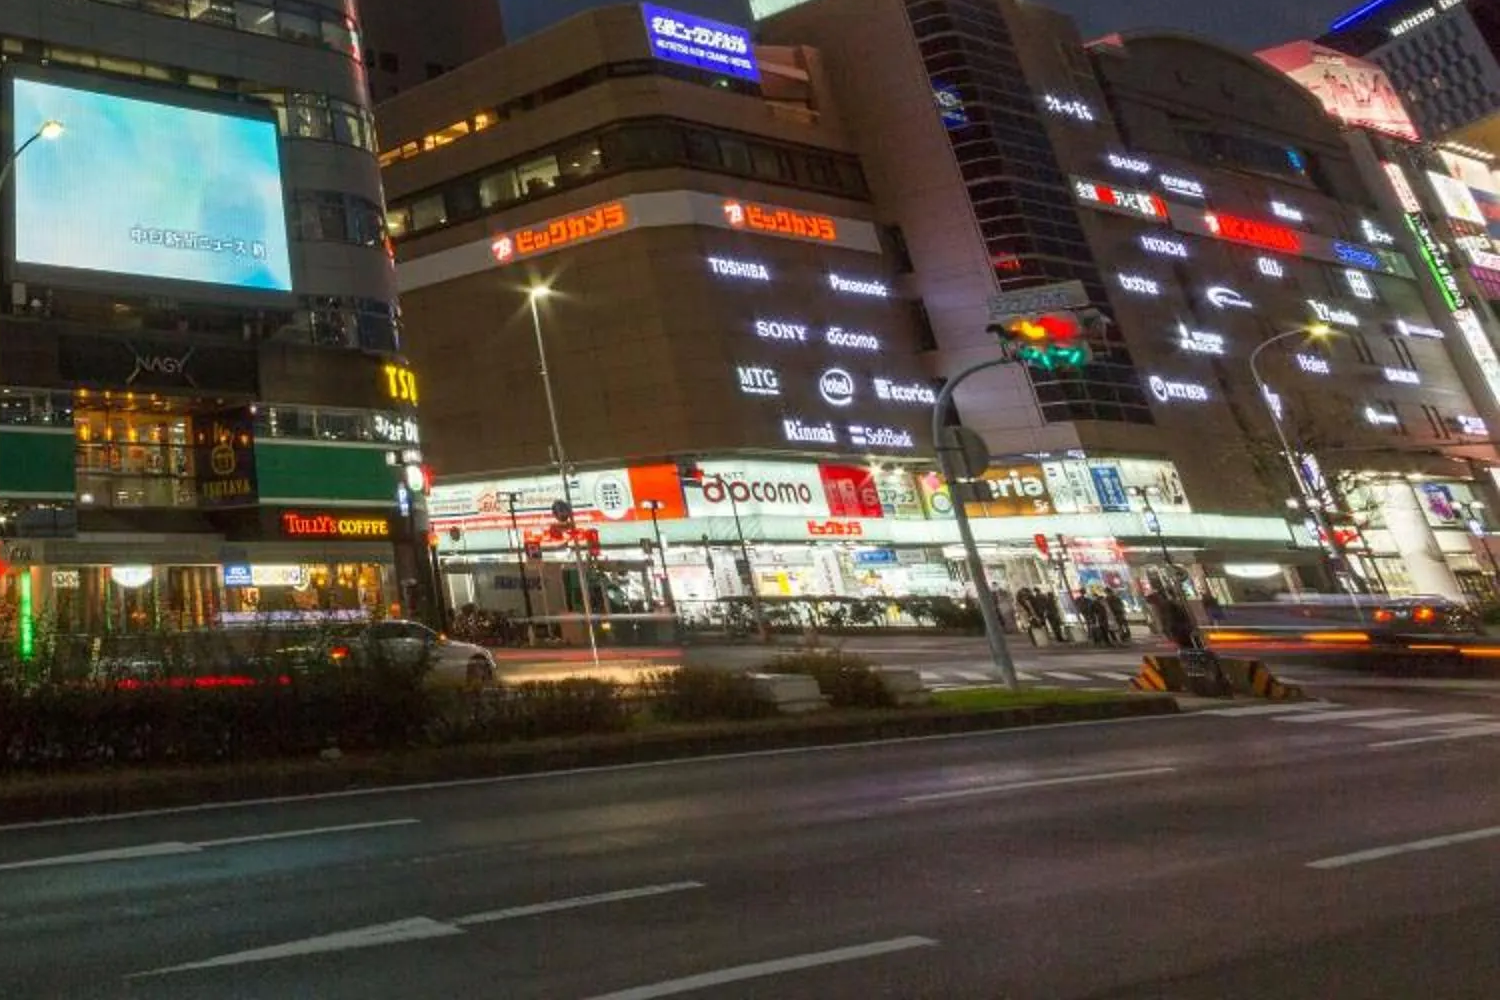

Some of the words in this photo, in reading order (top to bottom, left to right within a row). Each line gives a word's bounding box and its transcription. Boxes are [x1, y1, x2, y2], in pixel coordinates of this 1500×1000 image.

[515, 203, 625, 253] ビックカメラ
[744, 205, 836, 242] ビックカメラ
[708, 257, 769, 281] TOSHIBA
[829, 273, 887, 297] Panasonic
[755, 320, 807, 340] SONY
[737, 366, 778, 388] MTG
[783, 419, 837, 443] Rinnai
[865, 427, 914, 448] SoftBank
[703, 472, 812, 504] docomo
